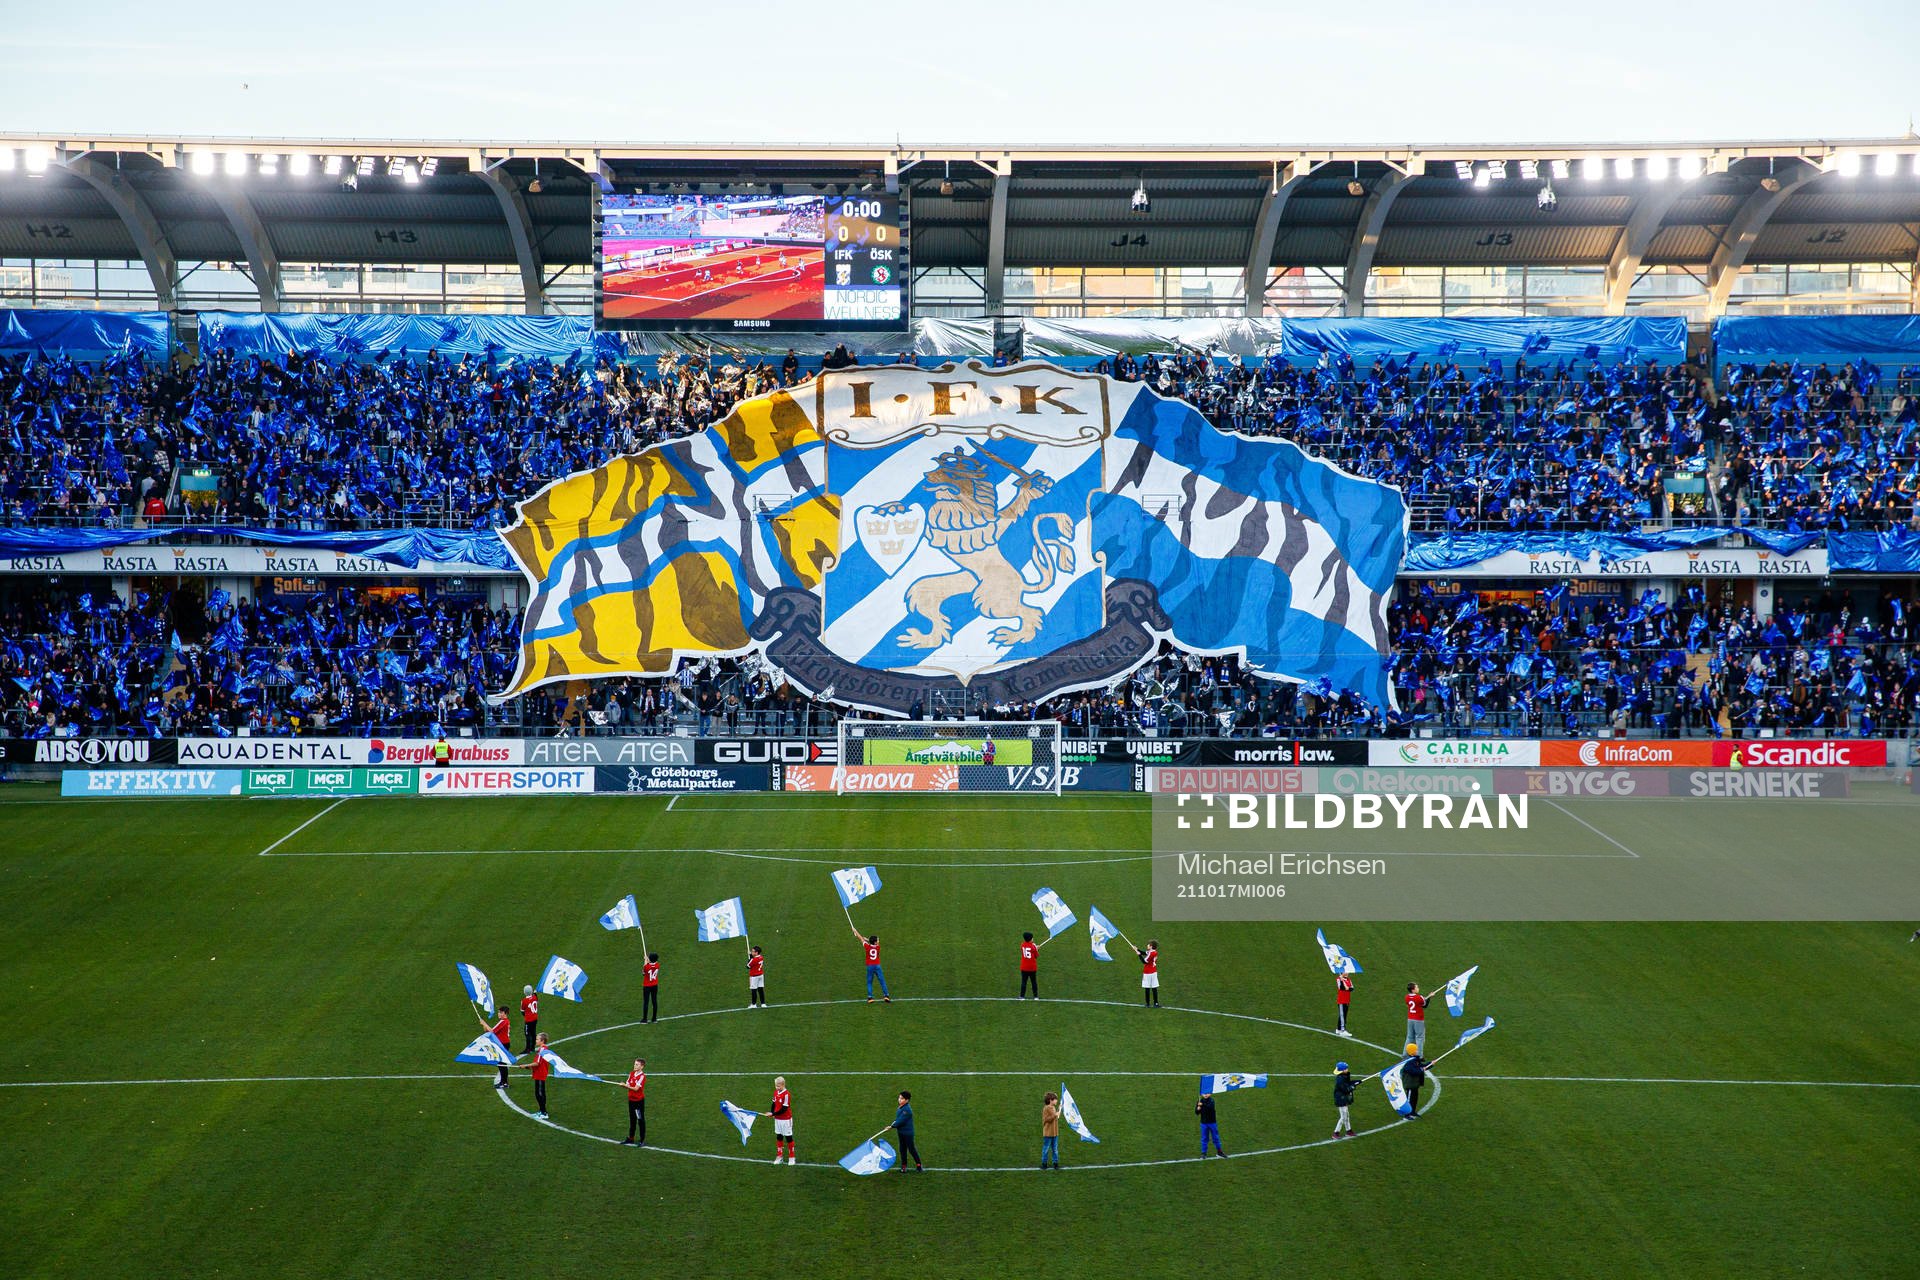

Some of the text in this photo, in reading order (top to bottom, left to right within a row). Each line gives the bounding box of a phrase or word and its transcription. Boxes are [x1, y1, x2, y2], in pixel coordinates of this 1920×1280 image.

[843, 201, 881, 218] 0:00
[27, 224, 74, 239] H2
[374, 229, 418, 244] H3
[839, 226, 886, 242] 0 0
[1806, 229, 1848, 244] J2
[1111, 234, 1150, 248] J4
[1476, 233, 1514, 246] J3
[834, 248, 892, 261] IFK ÖSK
[836, 290, 888, 304] NORDIC
[825, 305, 900, 319] WELLNESS
[733, 320, 771, 328] SAMSUNG
[10, 557, 65, 570] RASTA
[103, 557, 158, 570] RASTA
[174, 557, 228, 570] RASTA
[265, 558, 319, 571] RASTA
[335, 558, 389, 571] RASTA
[1529, 561, 1583, 574] RASTA
[1689, 561, 1742, 574] RASTA
[1759, 561, 1812, 574] RASTA
[180, 743, 351, 760] AQUADENTAL
[530, 743, 602, 762] ATEA
[617, 743, 688, 762] ATEA
[713, 742, 838, 763] GUIDE
[1126, 742, 1184, 754] UNIBET
[1235, 746, 1293, 762] morris
[1427, 743, 1509, 755] CARINA
[1604, 745, 1673, 762] InfraCom
[1747, 742, 1850, 765] Scandic
[255, 773, 286, 785] MCR
[314, 773, 344, 785] MCR
[373, 773, 403, 785] MCR
[447, 772, 585, 788] INTERSPORT
[651, 767, 718, 779] Göteborgs
[772, 763, 781, 790] SELECT
[829, 767, 914, 790] Renova
[1135, 763, 1143, 791] SELECT
[1161, 771, 1301, 789] BAUHAUS
[88, 772, 216, 790] EFFEKTIV
[647, 778, 736, 789] Metallpartier
[1363, 770, 1478, 792] Rekomo
[1690, 771, 1820, 798] SERNEKE
[869, 949, 877, 960] 9
[648, 968, 659, 982] 14
[528, 1001, 538, 1014] 10
[1408, 1000, 1417, 1013] 2
